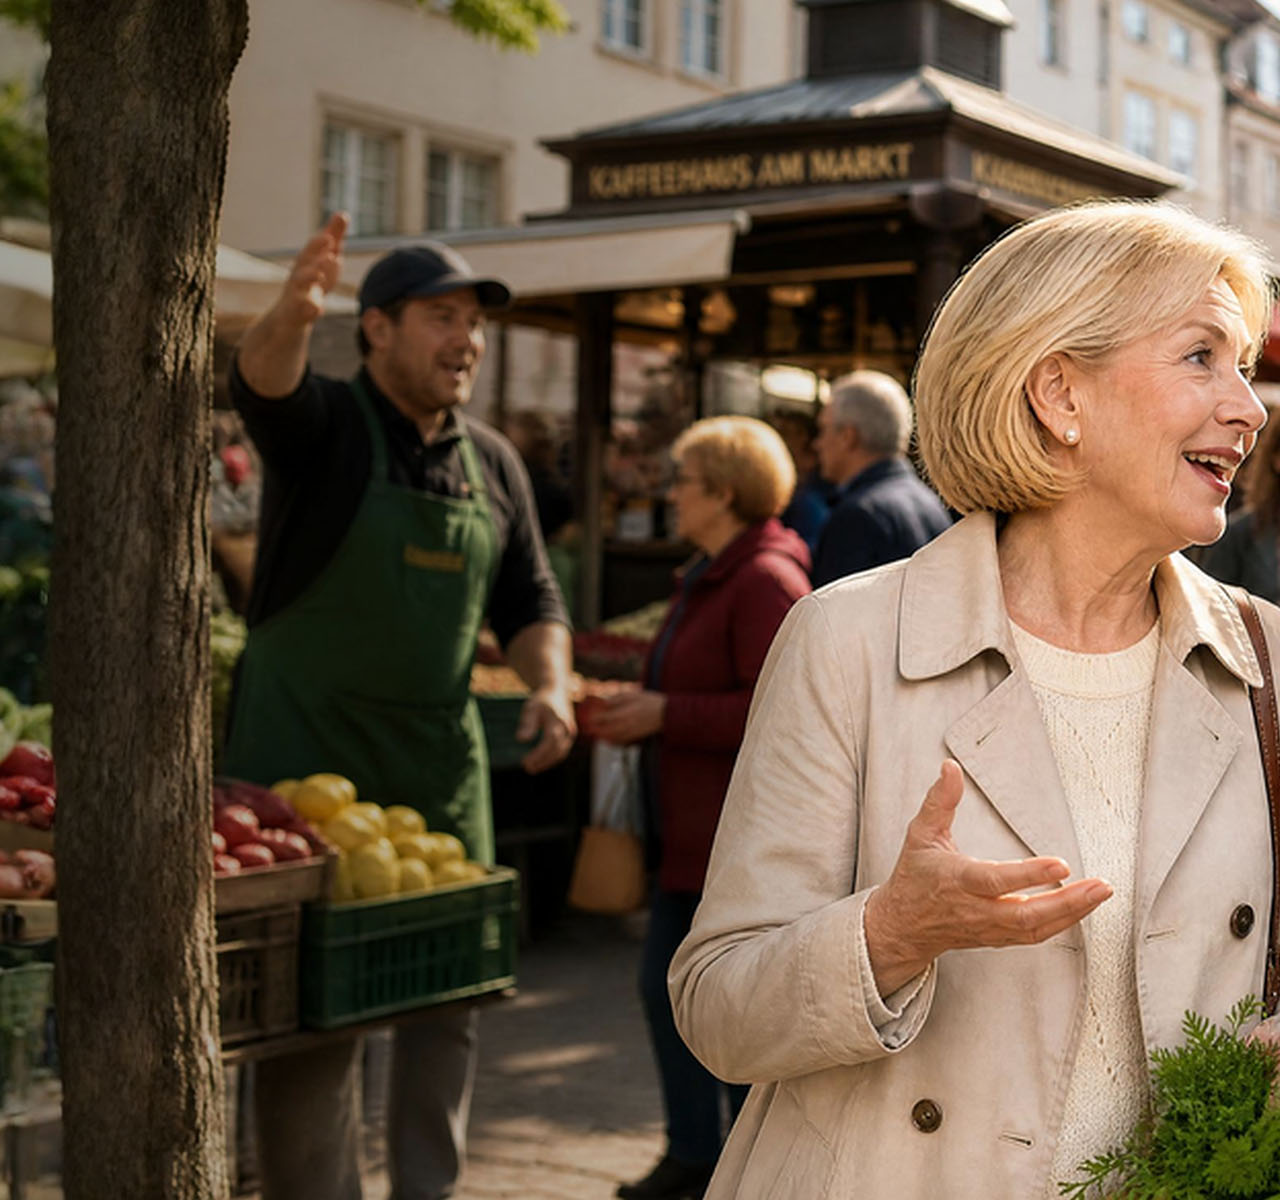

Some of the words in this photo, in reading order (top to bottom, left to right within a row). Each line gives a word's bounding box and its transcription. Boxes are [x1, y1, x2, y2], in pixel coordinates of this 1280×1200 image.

[589, 154, 753, 198] KAFFEEHAUS
[756, 152, 804, 187] AM
[809, 143, 913, 183] MARKT
